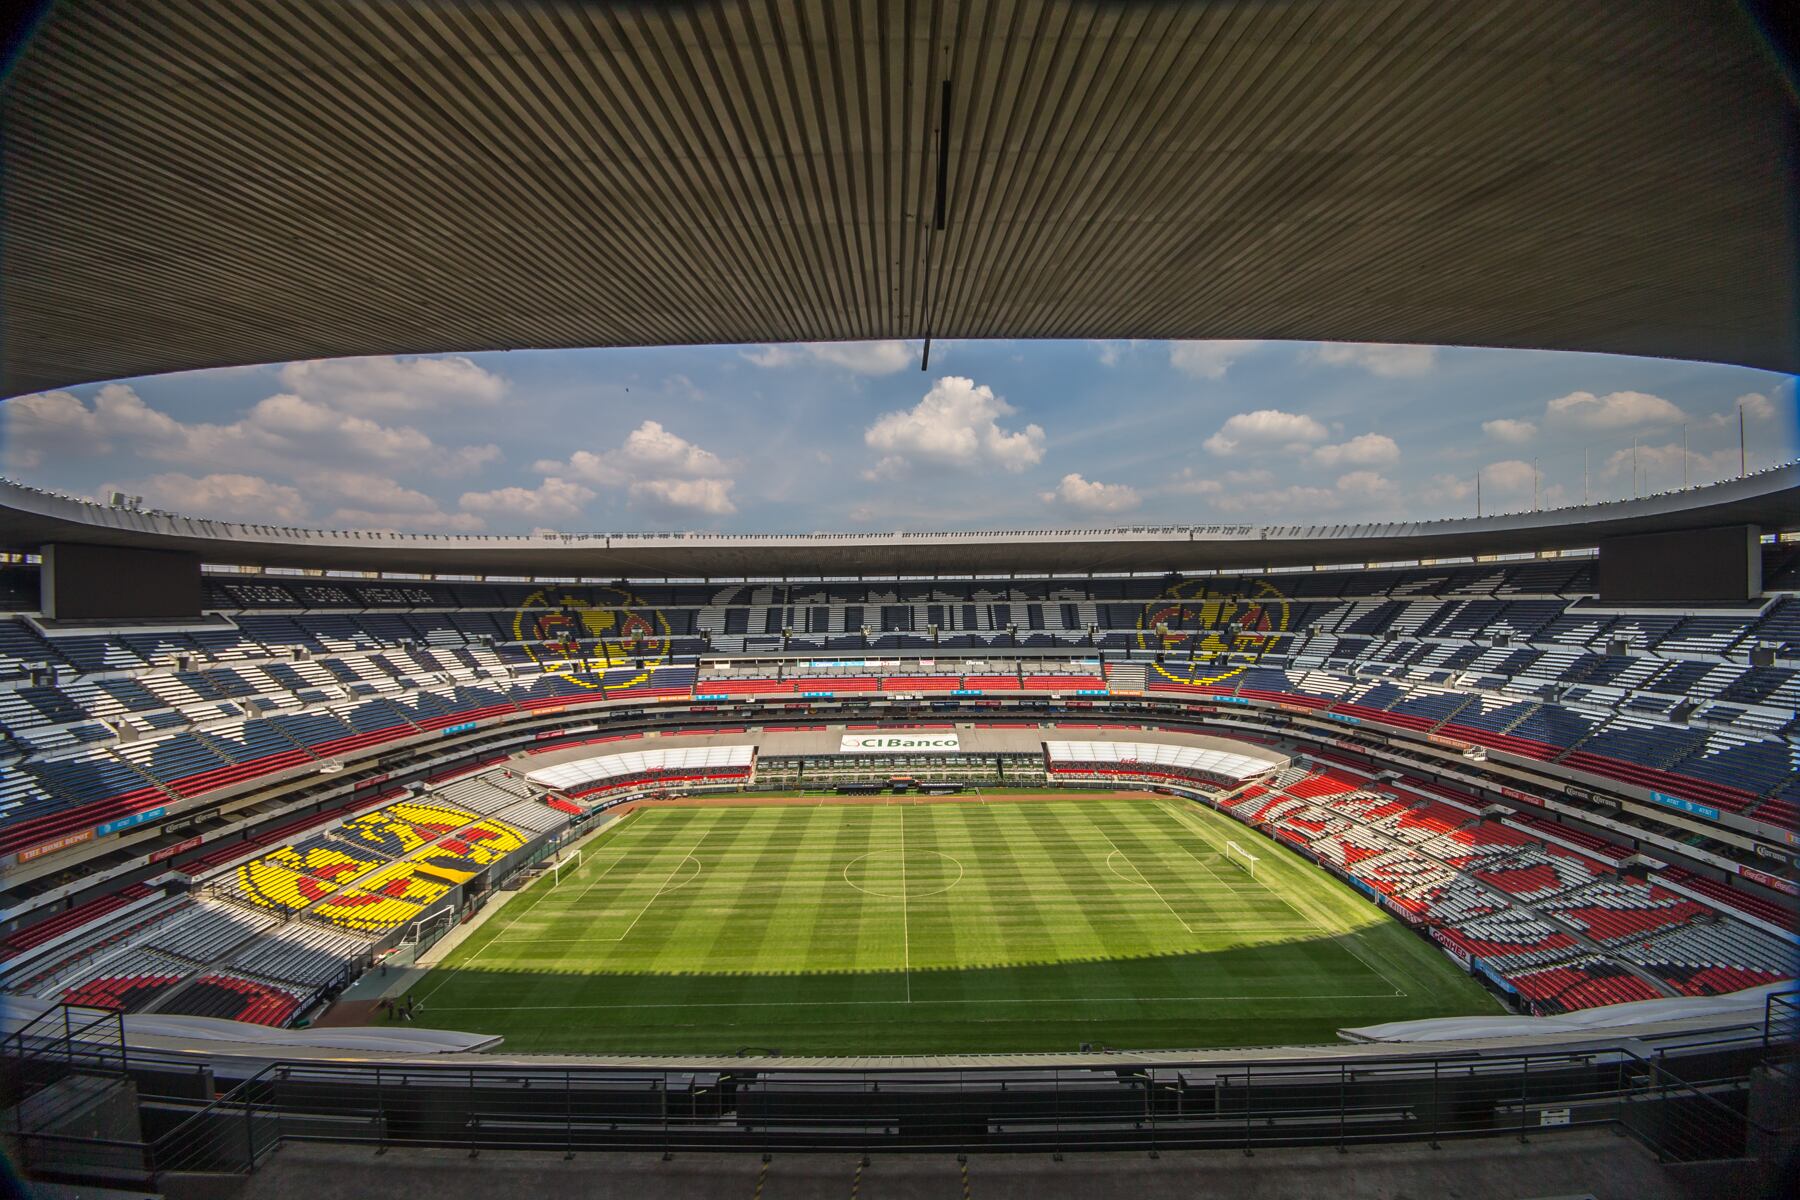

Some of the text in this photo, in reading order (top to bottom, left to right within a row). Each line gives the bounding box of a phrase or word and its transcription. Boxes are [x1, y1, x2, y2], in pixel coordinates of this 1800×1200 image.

[1566, 787, 1588, 799] Corona
[1592, 795, 1617, 808] Corona
[1666, 797, 1679, 805] AT&T
[1698, 807, 1712, 816] AT&T
[1757, 845, 1787, 862] Corona
[1432, 930, 1467, 960] GONHER
